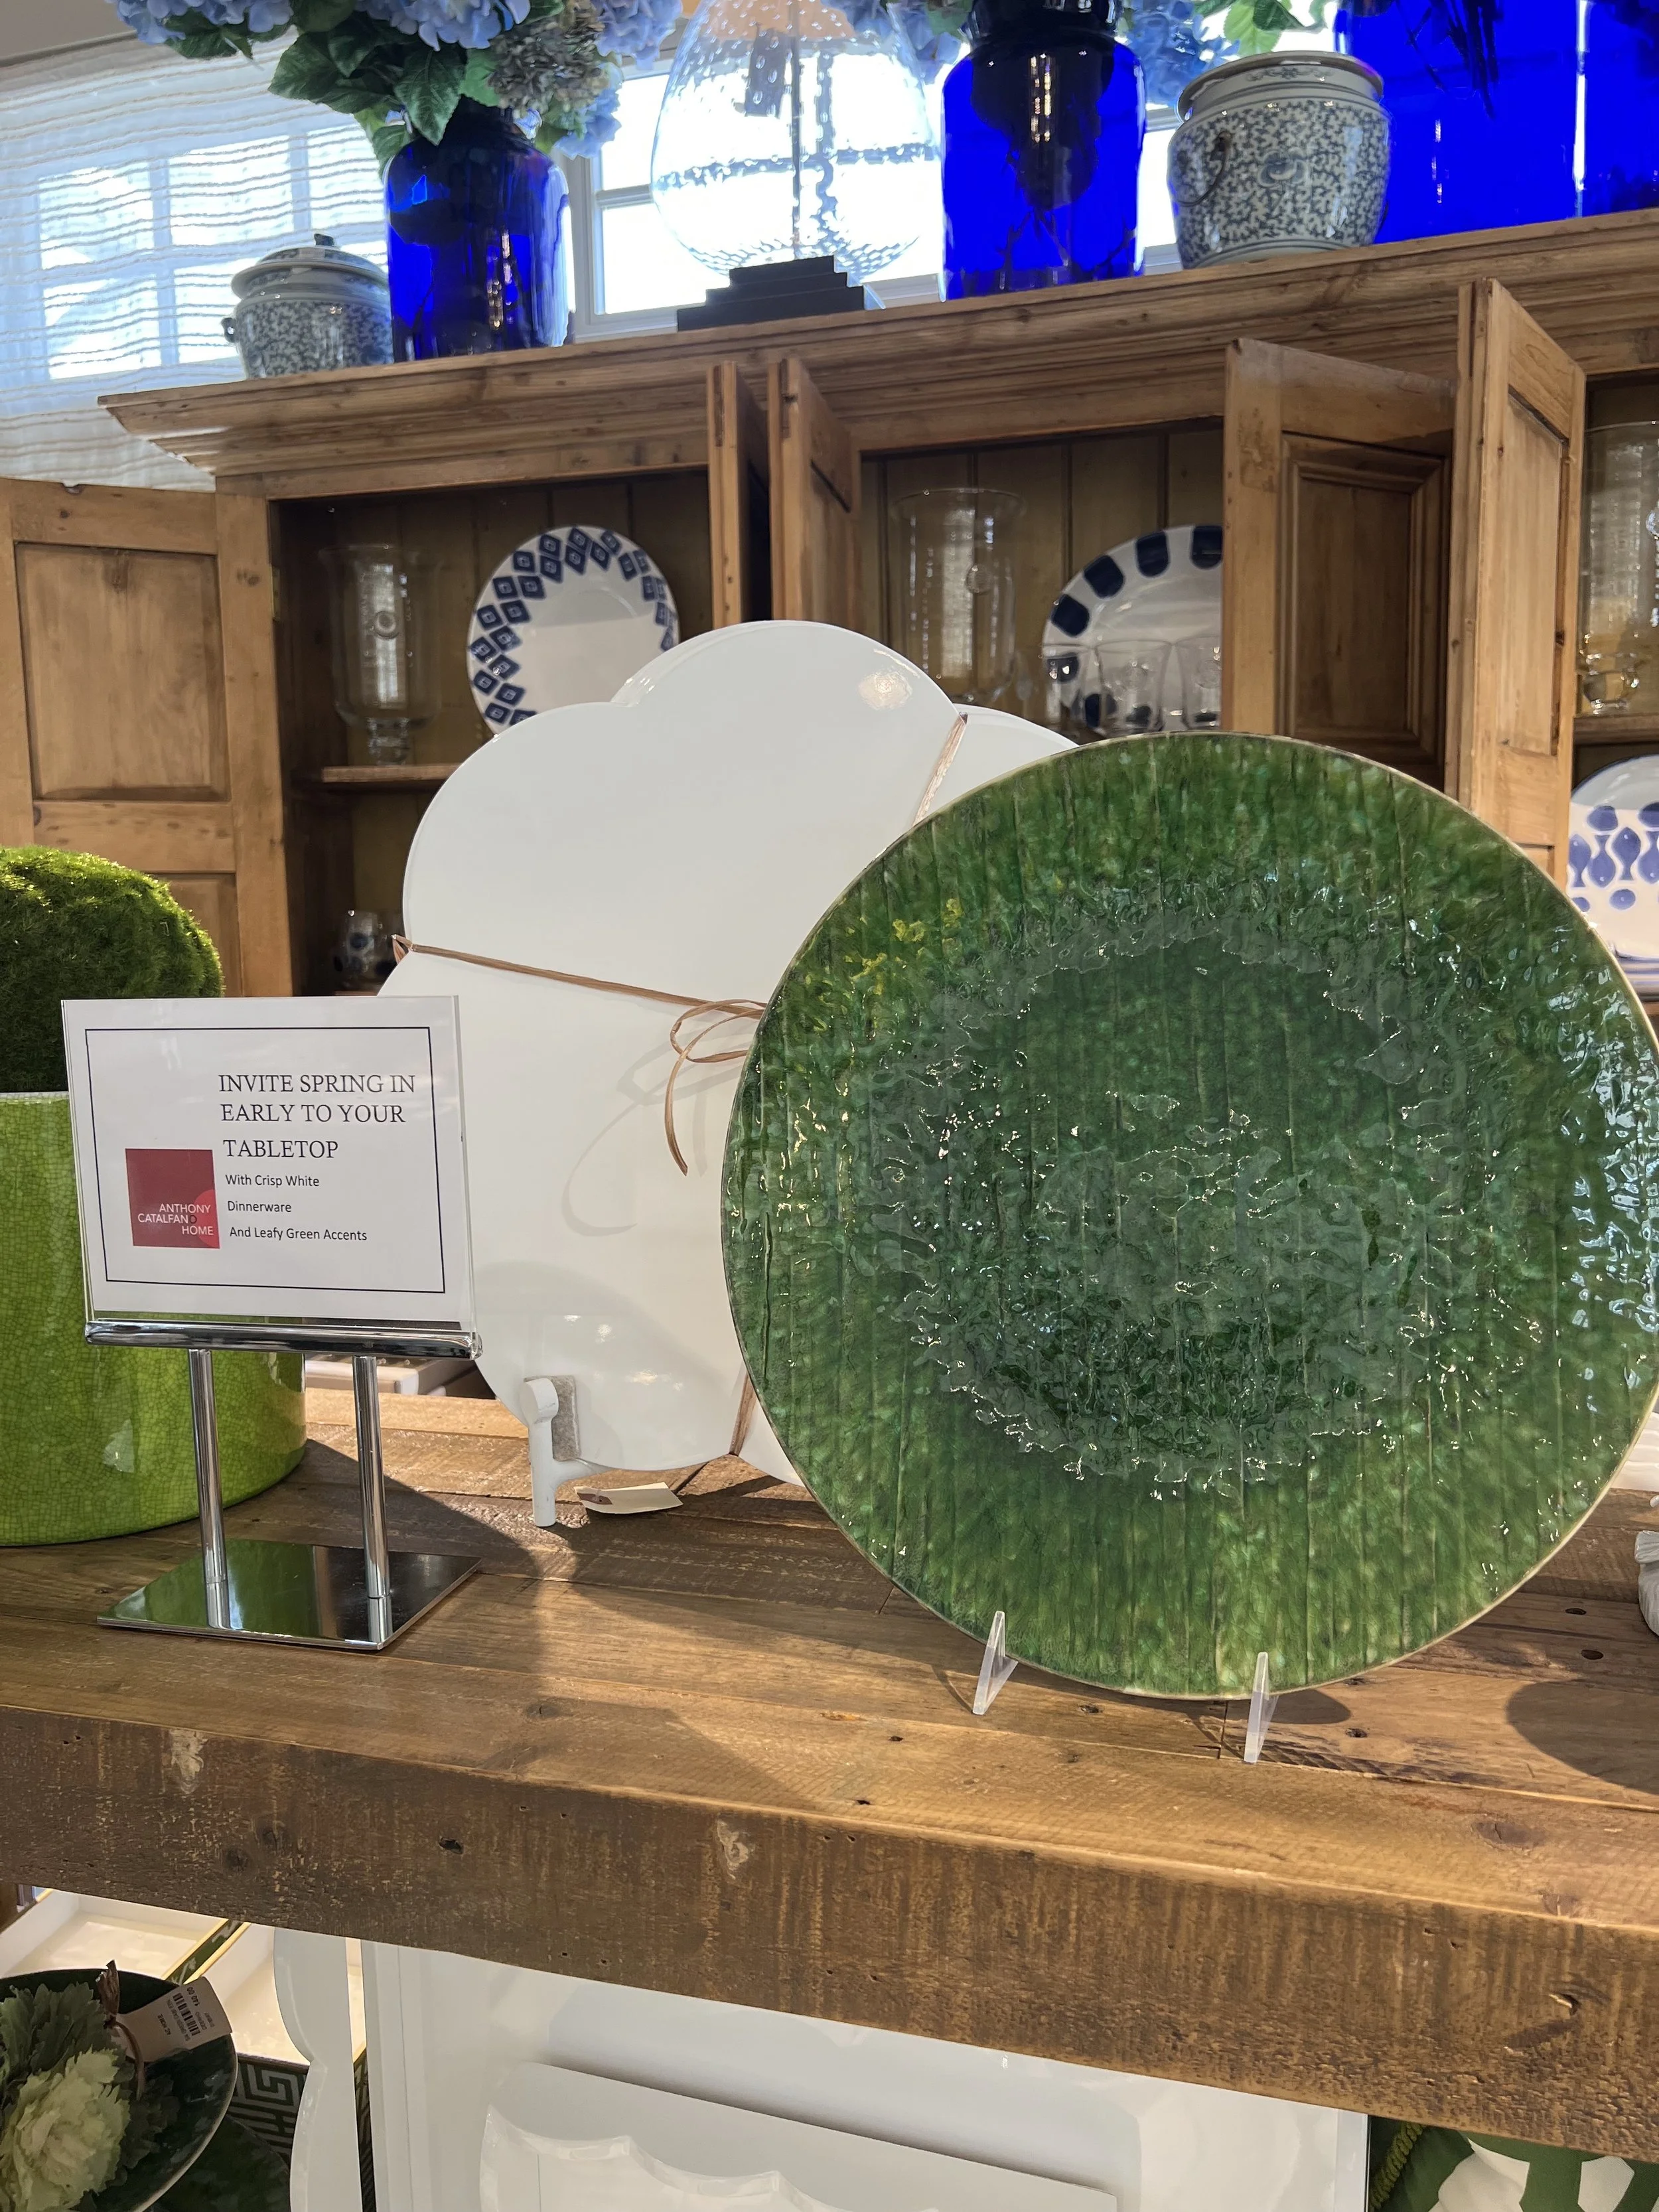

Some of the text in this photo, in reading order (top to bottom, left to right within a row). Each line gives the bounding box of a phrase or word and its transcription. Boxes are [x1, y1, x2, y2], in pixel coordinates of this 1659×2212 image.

[218, 1074, 415, 1093] INVITE SPRING IN
[220, 1104, 406, 1123] EARLY TO YOUR
[223, 1140, 338, 1159] TABLETOP
[225, 1174, 320, 1188] With Crisp White
[159, 1203, 211, 1214] ANTHONY
[228, 1201, 292, 1213] Dinnerware
[137, 1213, 198, 1224] CATALFANO
[182, 1225, 214, 1236] HOME
[230, 1226, 368, 1241] And Leafy Green Accents
